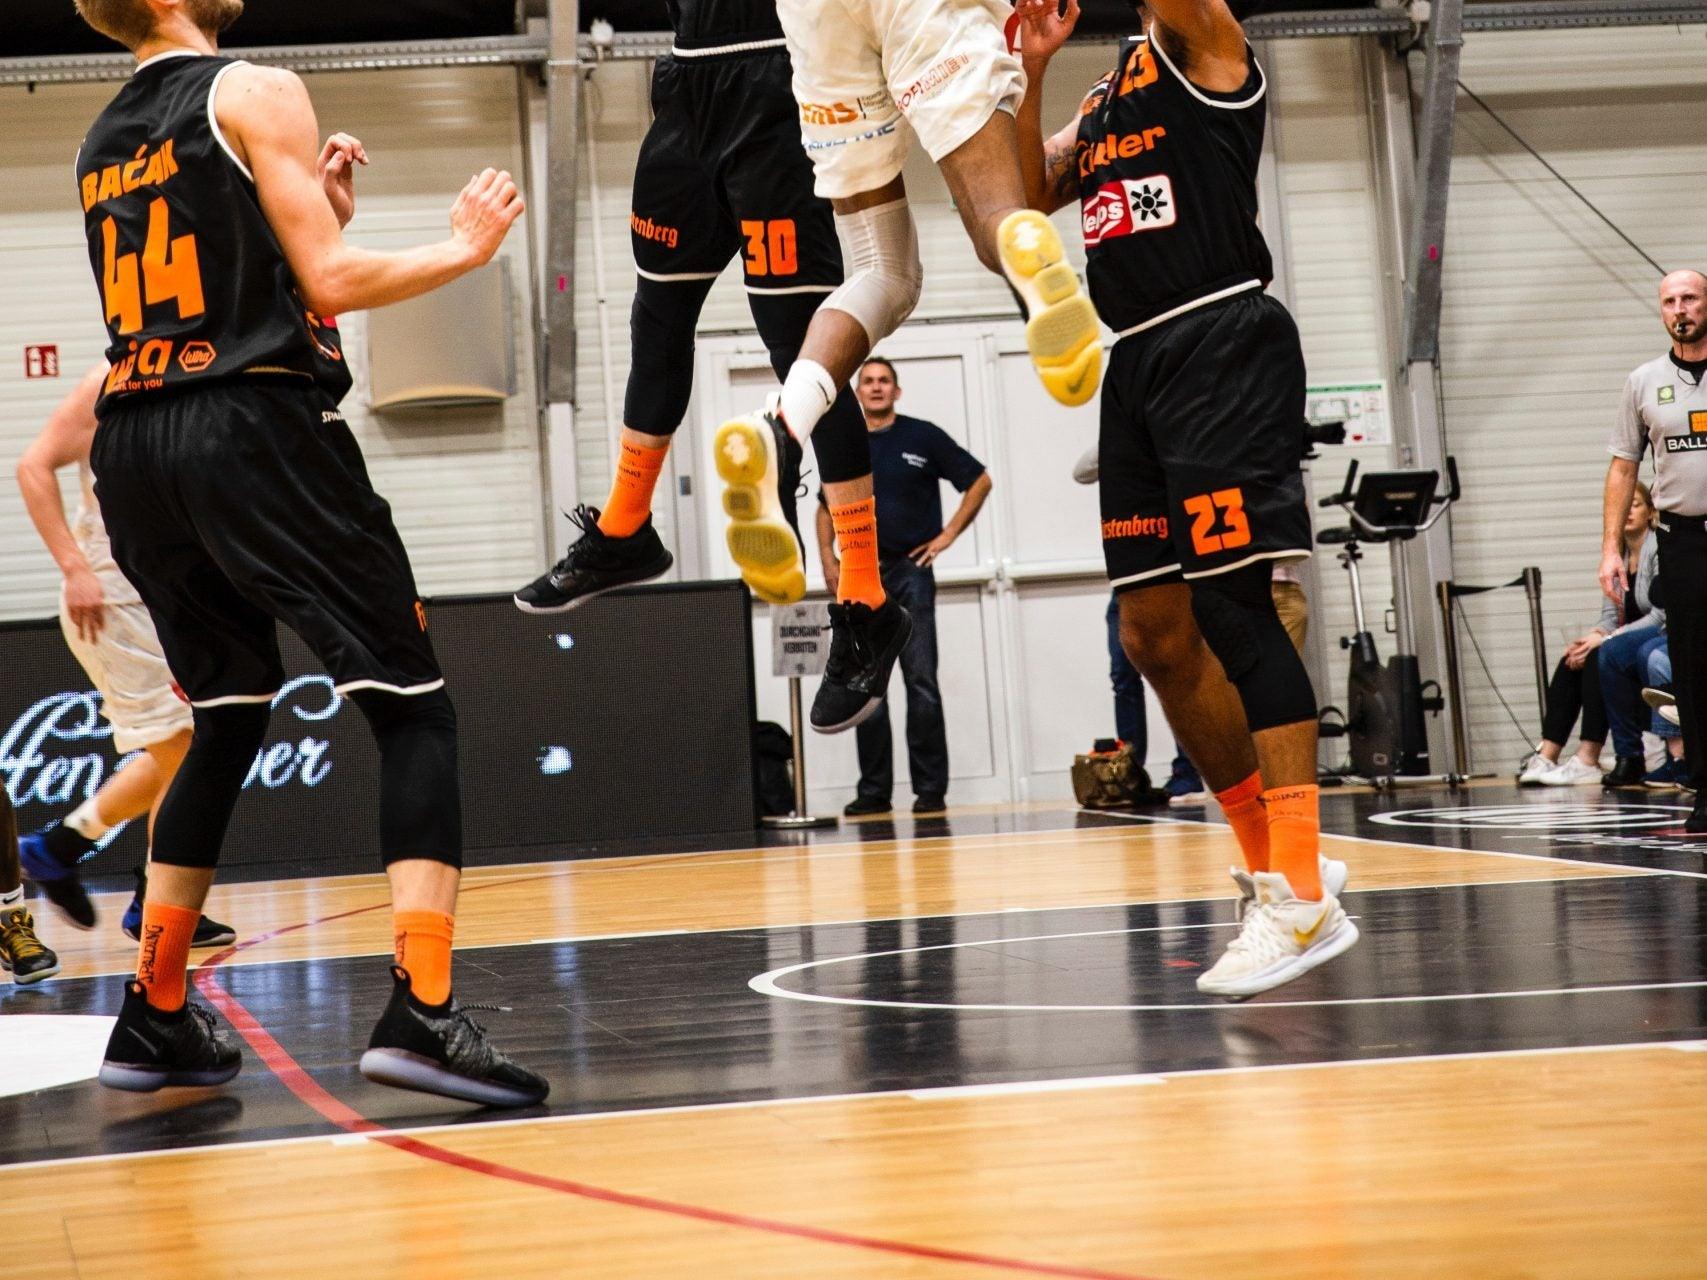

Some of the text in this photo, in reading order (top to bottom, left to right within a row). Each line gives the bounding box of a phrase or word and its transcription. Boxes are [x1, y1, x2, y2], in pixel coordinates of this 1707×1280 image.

[101, 197, 206, 335] 44
[741, 218, 798, 276] 30
[128, 380, 142, 391] for
[143, 378, 164, 393] you
[1667, 437, 1707, 451] BALL
[1184, 487, 1251, 556] 23
